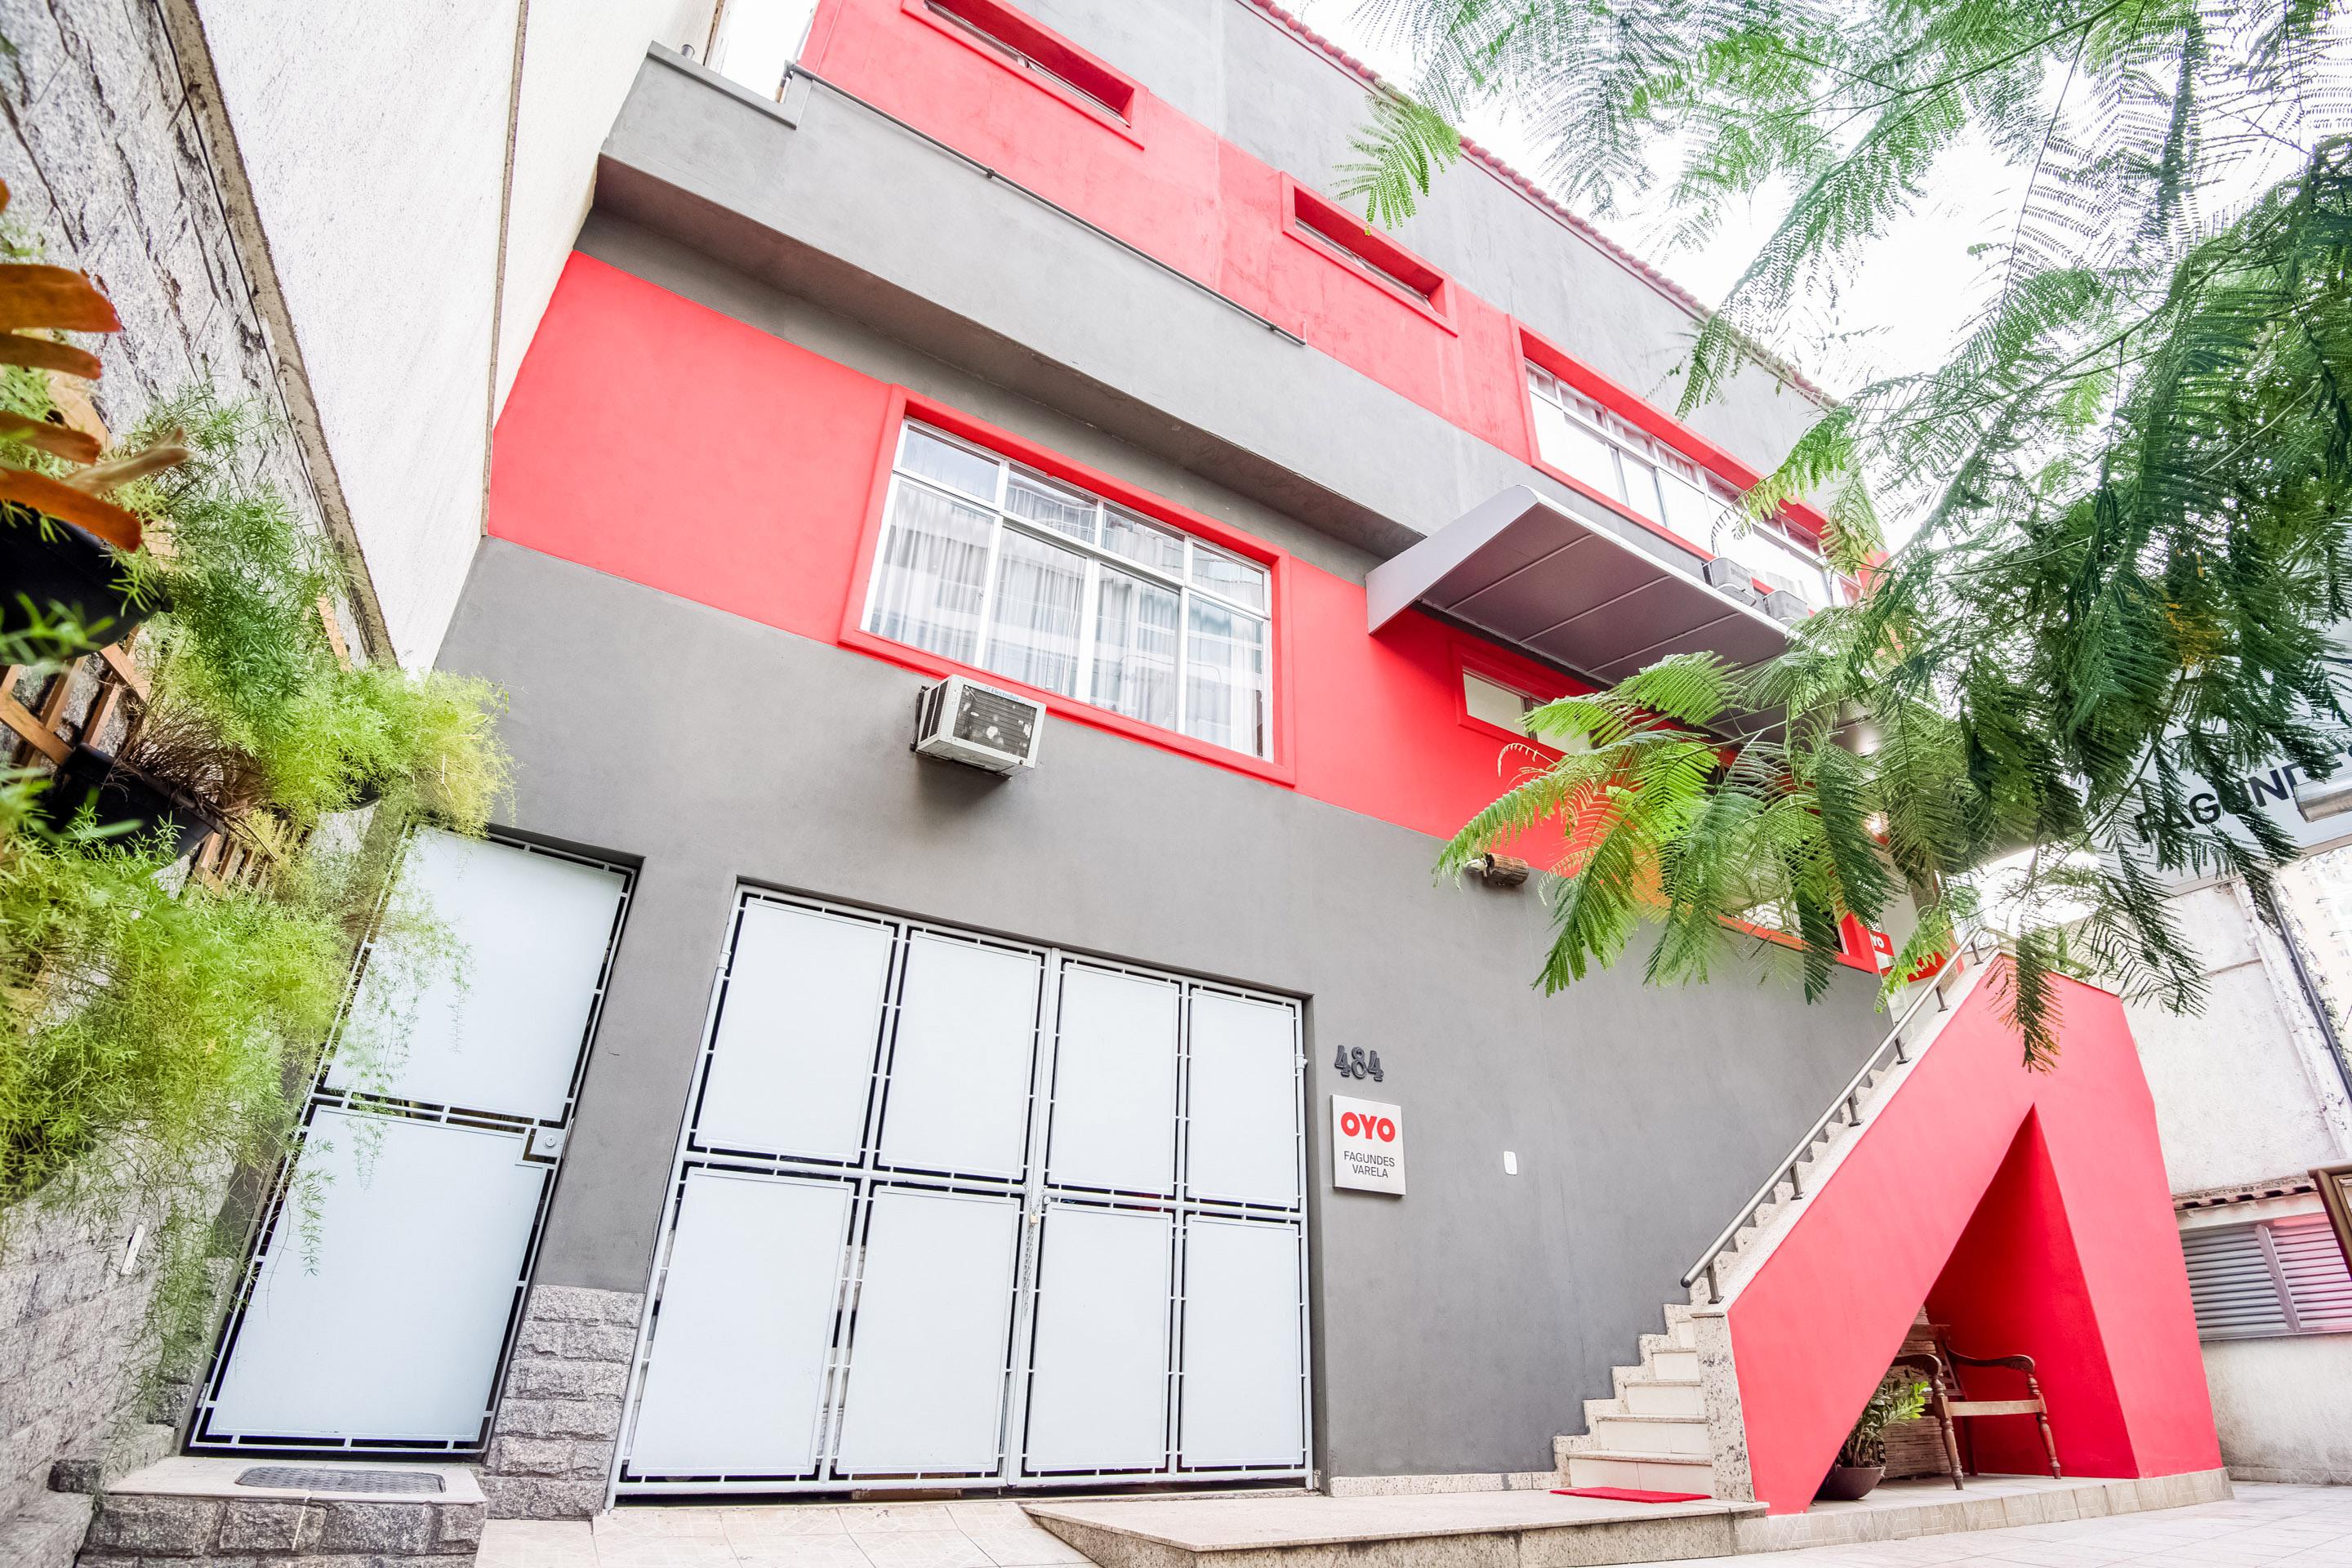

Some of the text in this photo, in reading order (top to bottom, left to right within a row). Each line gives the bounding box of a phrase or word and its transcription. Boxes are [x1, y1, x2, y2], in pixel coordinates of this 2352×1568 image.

[1334, 1045, 1383, 1081] 484
[1341, 1111, 1396, 1143] OYO
[1344, 1151, 1395, 1167] FAGUNDES
[1352, 1164, 1388, 1178] VARELA
